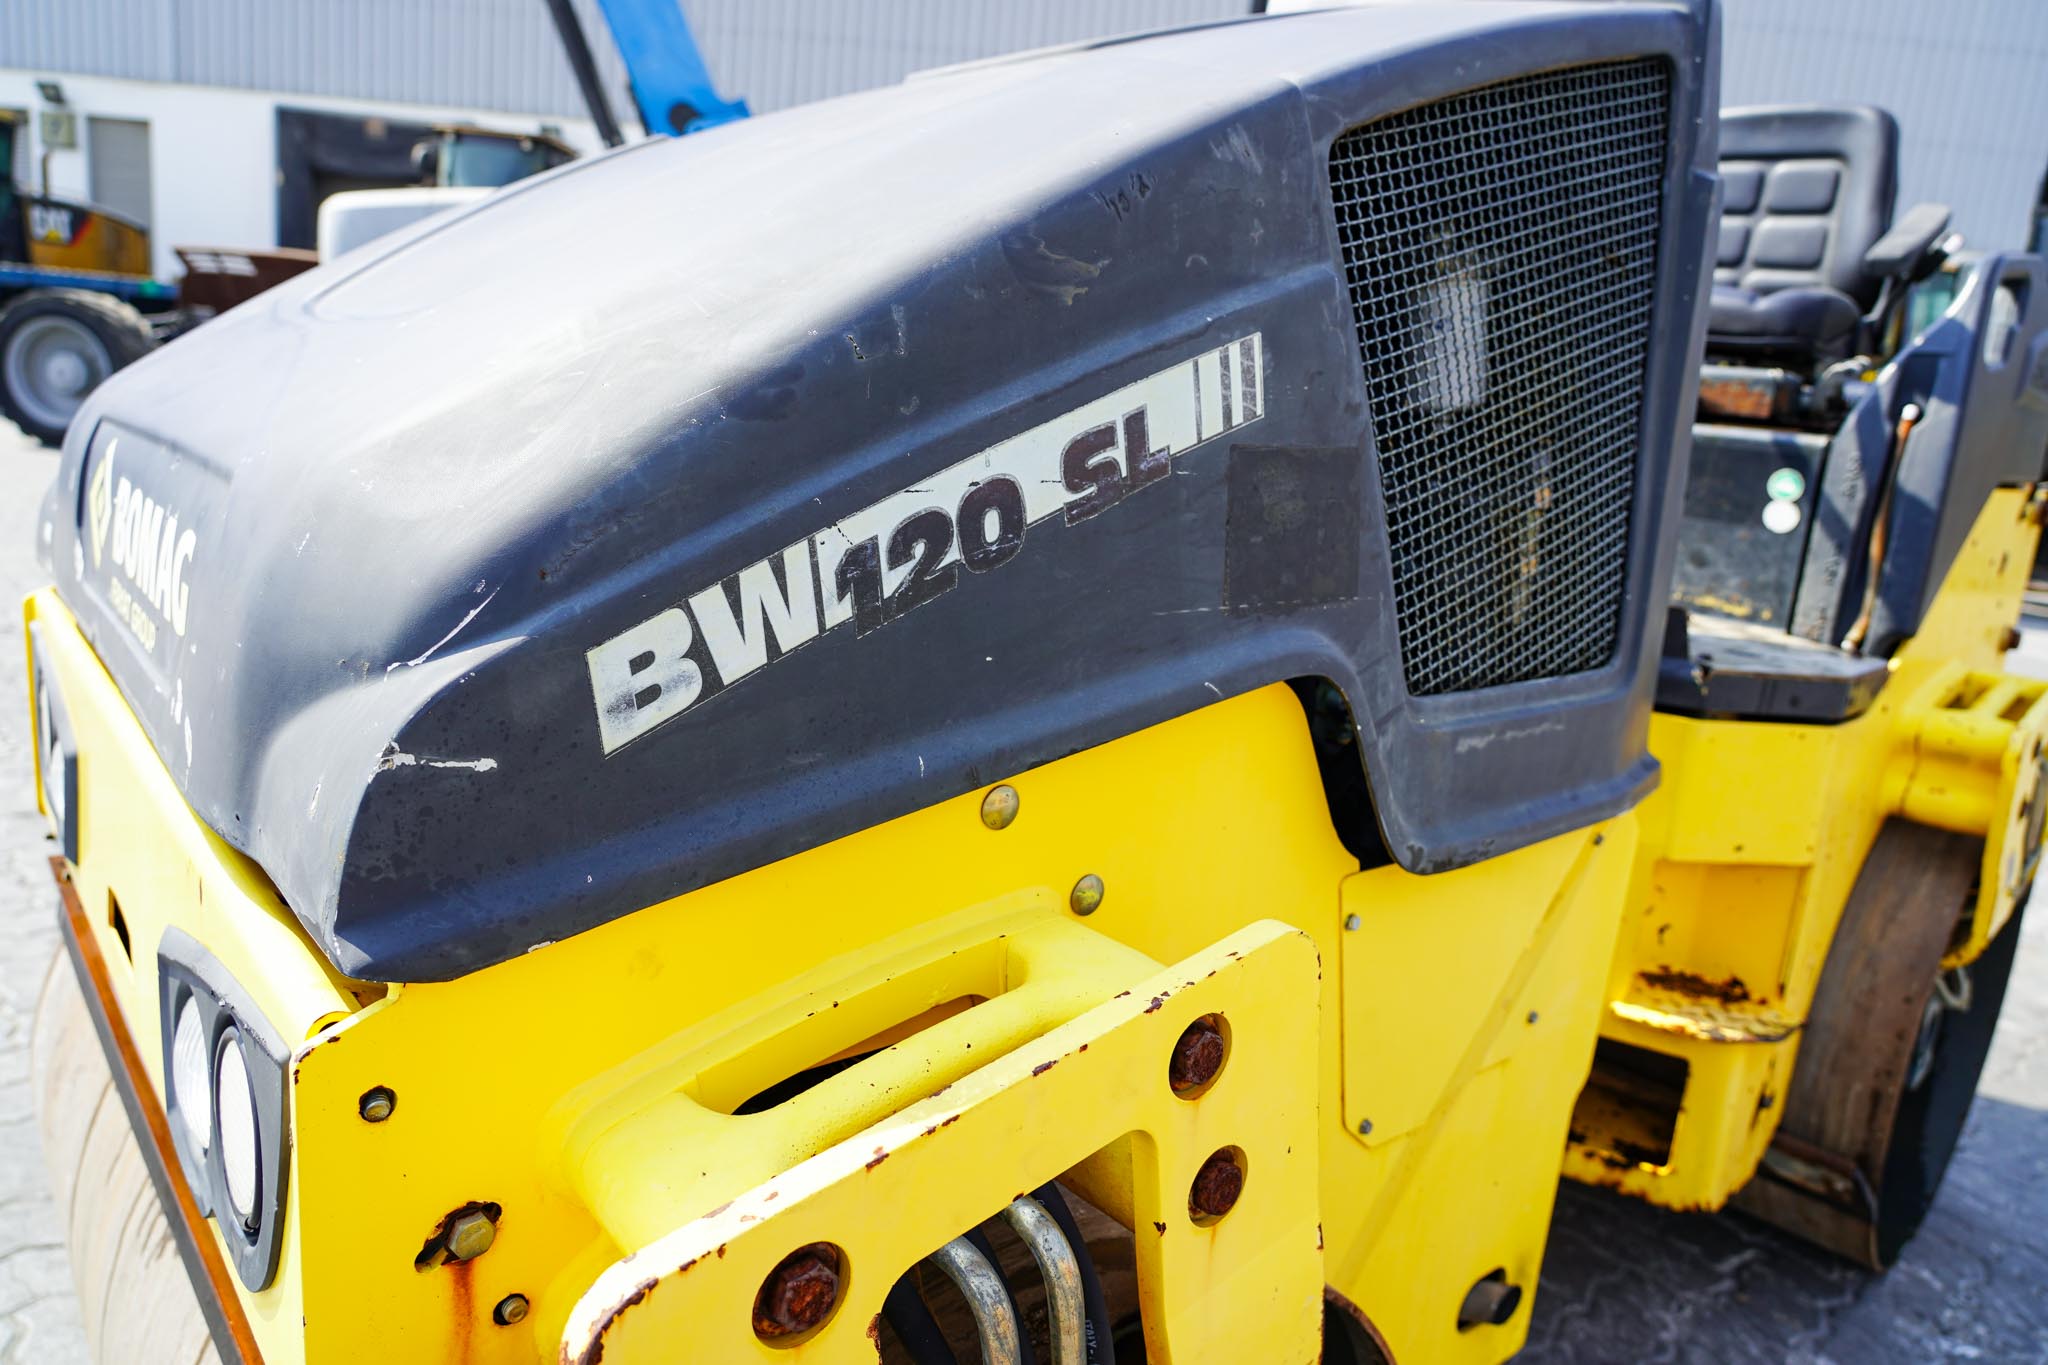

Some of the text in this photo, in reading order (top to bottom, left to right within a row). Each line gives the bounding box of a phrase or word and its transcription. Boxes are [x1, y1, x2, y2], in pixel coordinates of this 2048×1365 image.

[111, 475, 197, 637] BOMAG
[585, 404, 1171, 755] BW 120 SL
